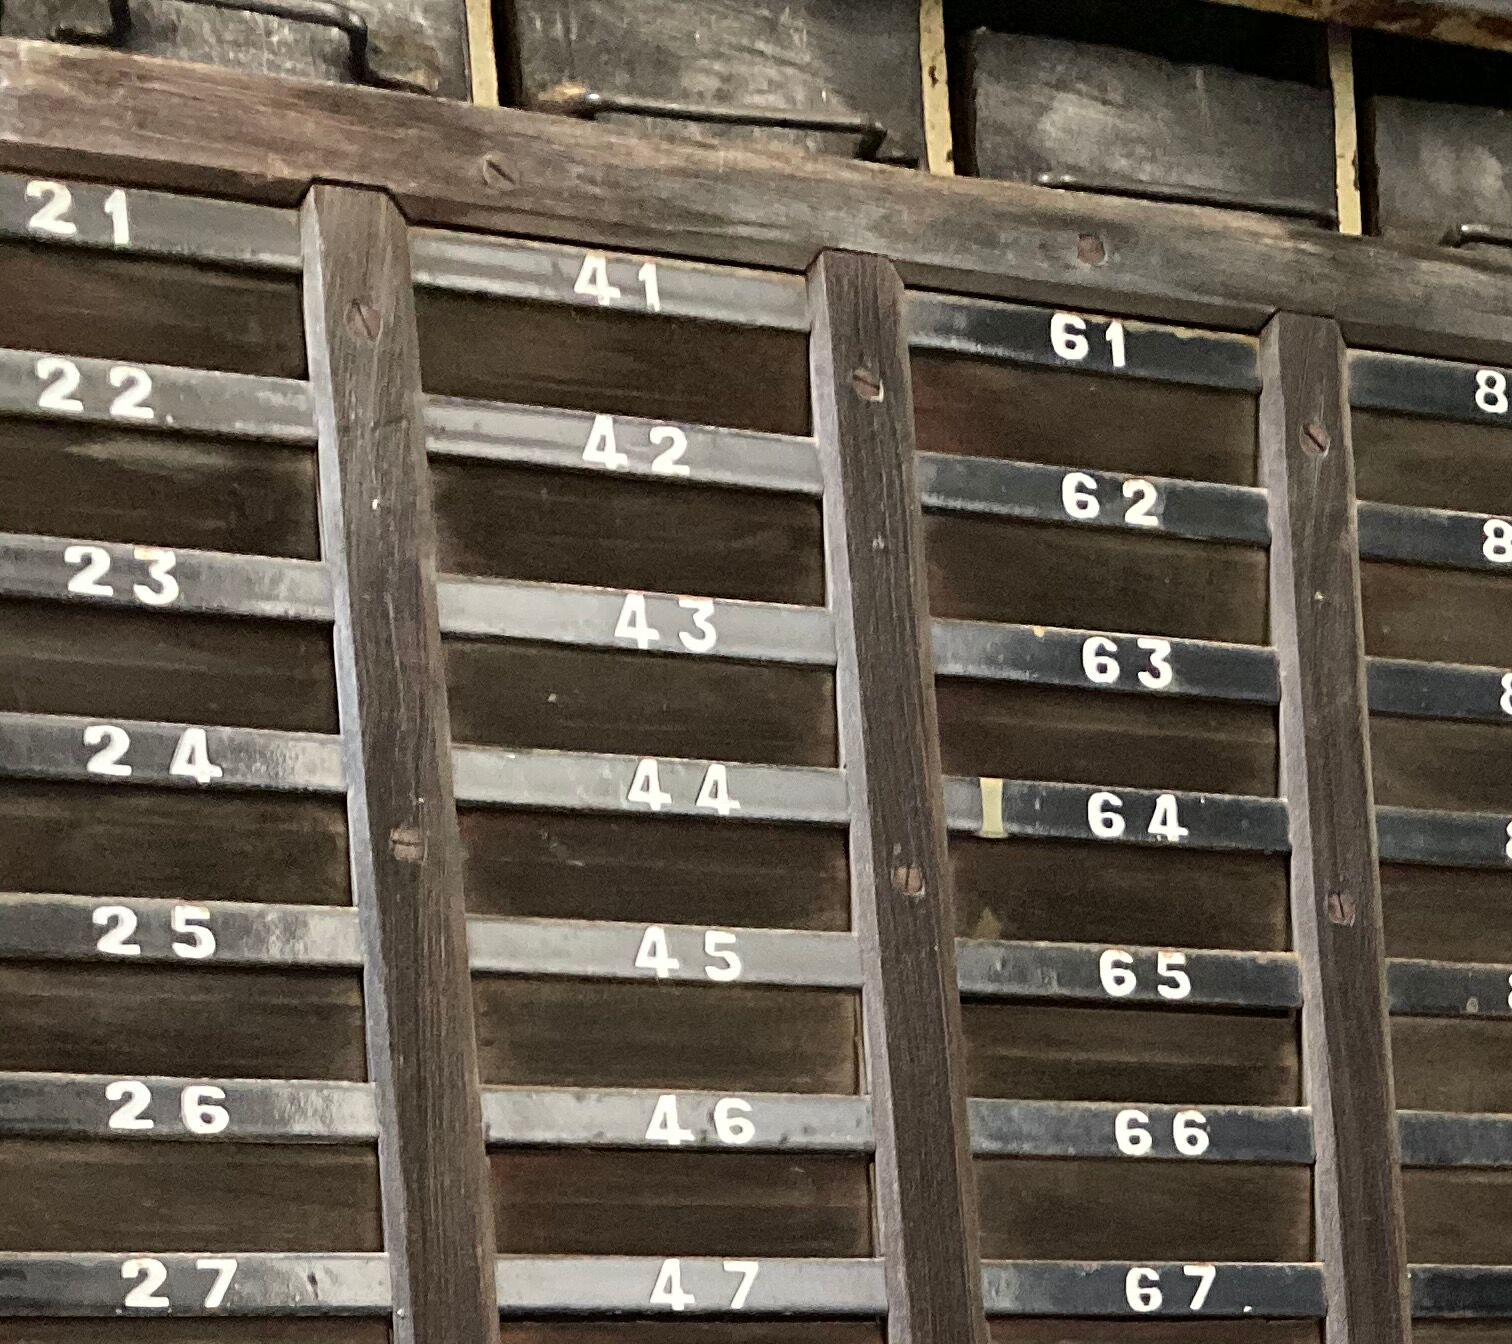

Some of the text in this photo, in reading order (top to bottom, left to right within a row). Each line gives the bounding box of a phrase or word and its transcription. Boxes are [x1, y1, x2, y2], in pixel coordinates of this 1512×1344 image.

[25, 180, 132, 246] 21
[574, 250, 662, 312] 41
[37, 355, 154, 419] 22
[1062, 472, 1160, 528] 62
[614, 592, 718, 653] 43
[1083, 637, 1172, 688] 63
[84, 725, 222, 783] 24
[628, 759, 744, 815] 44
[1088, 792, 1188, 842] 64
[93, 902, 215, 958] 25
[635, 924, 744, 981] 45
[106, 1080, 229, 1134] 26
[1115, 1109, 1209, 1156] 66
[650, 1258, 760, 1310] 47
[1126, 1263, 1215, 1312] 67
